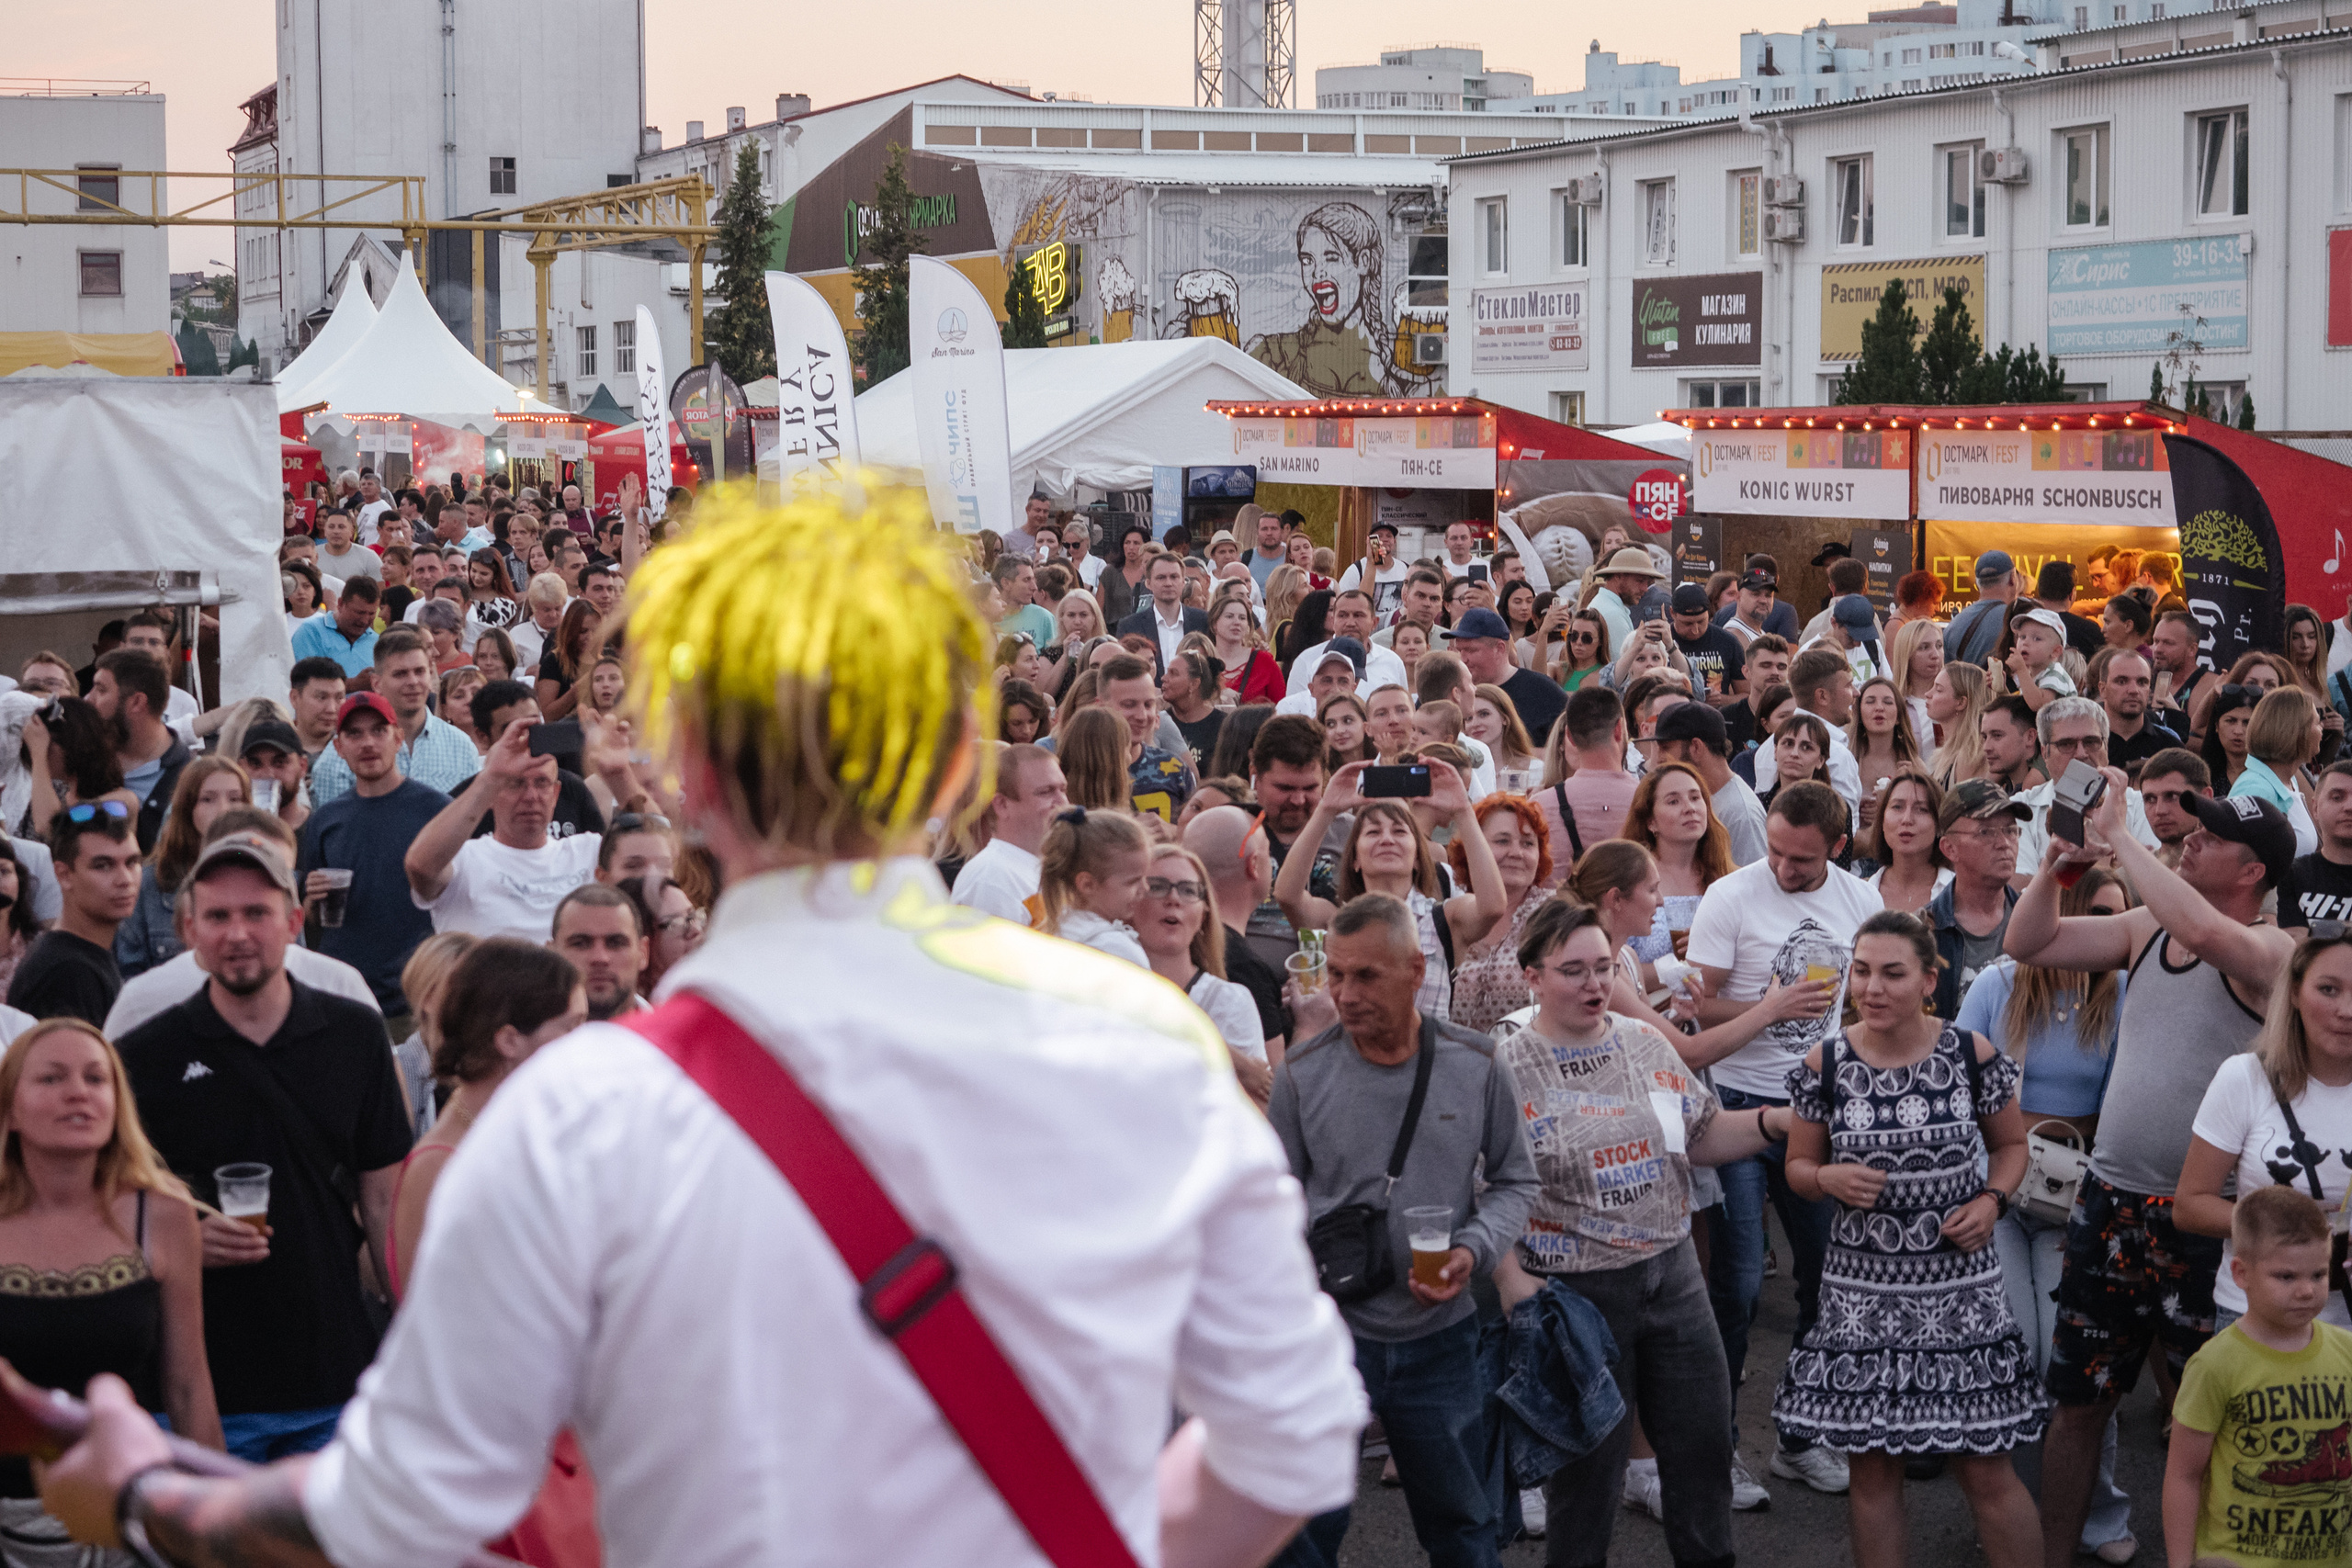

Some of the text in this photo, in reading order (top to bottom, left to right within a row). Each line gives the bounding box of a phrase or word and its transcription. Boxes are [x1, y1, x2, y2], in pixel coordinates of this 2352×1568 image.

[910, 193, 956, 230] ЯРМАРКА
[2072, 254, 2130, 287] Сирис
[1830, 283, 1881, 303] Распил
[1478, 291, 1580, 320] СтеклоМастер
[1702, 294, 1746, 316] МАГАЗИН
[2052, 294, 2135, 320] ОНЛАЙН-КАССЫ
[1652, 329, 1670, 342] FREE
[1695, 322, 1751, 345] КУЛИНАРИЯ
[2054, 331, 2104, 346] ТОРГОВОЕ
[2193, 323, 2242, 341] ХОСТИНГ
[944, 389, 961, 456] ЧИПС
[1243, 428, 1279, 443] ОСТМАРК FEST
[1367, 429, 1409, 444] ОСТМАРК FEST
[1714, 445, 1777, 462] ОСТМАРК FEST
[1944, 445, 2019, 464] ОСТМАРК FEST
[1260, 457, 1319, 473] SAN MARINO
[1401, 459, 1442, 475] ПЯН-СЕ
[1635, 482, 1679, 502] ПЯН
[1739, 480, 1854, 502] KONIG WURST
[1939, 485, 2162, 509] ПИВОВАРНЯ SCHONBUSCH
[2202, 573, 2230, 586] 1871
[1594, 1139, 1651, 1169] STOCK
[1597, 1157, 1664, 1191] MARKET
[2245, 1382, 2346, 1424] DENIM
[2236, 1532, 2278, 1548] MORE
[2284, 1535, 2323, 1551] THAN
